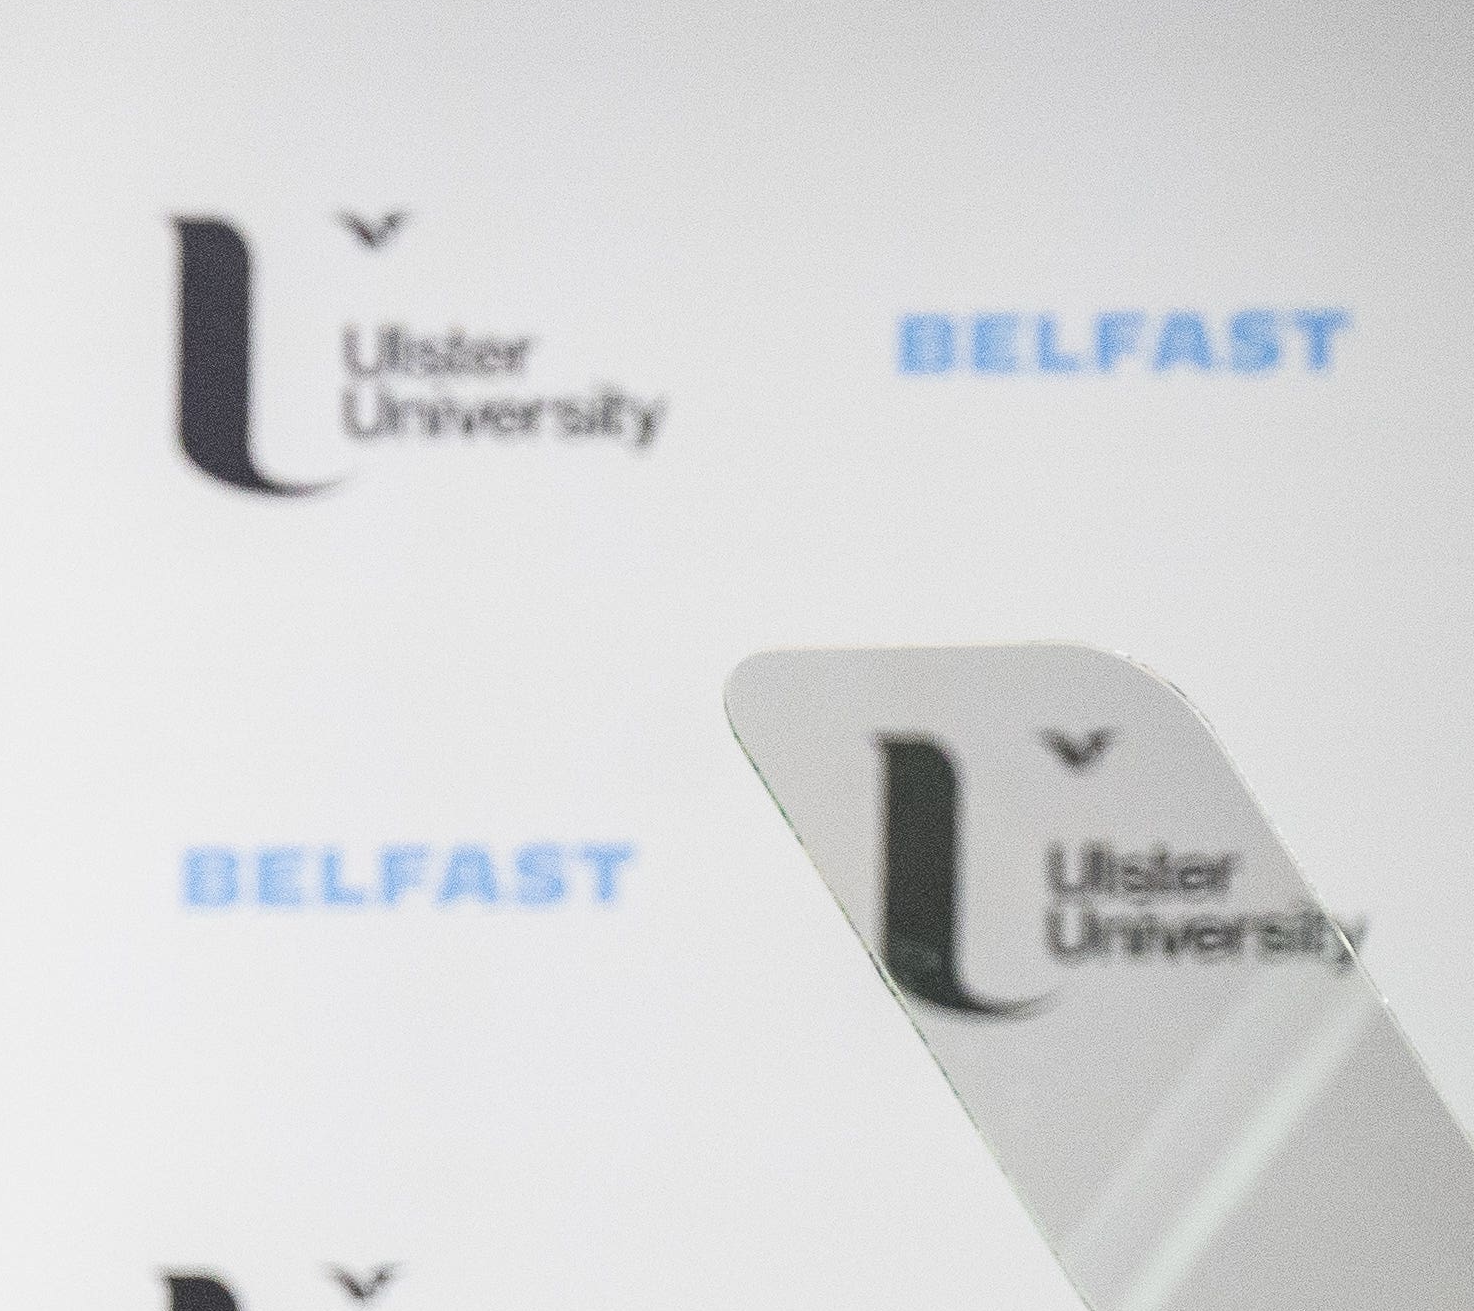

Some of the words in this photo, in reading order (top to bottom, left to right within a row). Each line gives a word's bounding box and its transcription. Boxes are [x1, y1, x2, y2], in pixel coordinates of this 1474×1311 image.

[344, 323, 532, 378] Ulster
[894, 305, 1351, 378] BELFAST
[343, 387, 662, 448] University
[179, 841, 635, 910] BELFAST
[1046, 842, 1238, 901] Ulster
[1045, 906, 1368, 972] University
